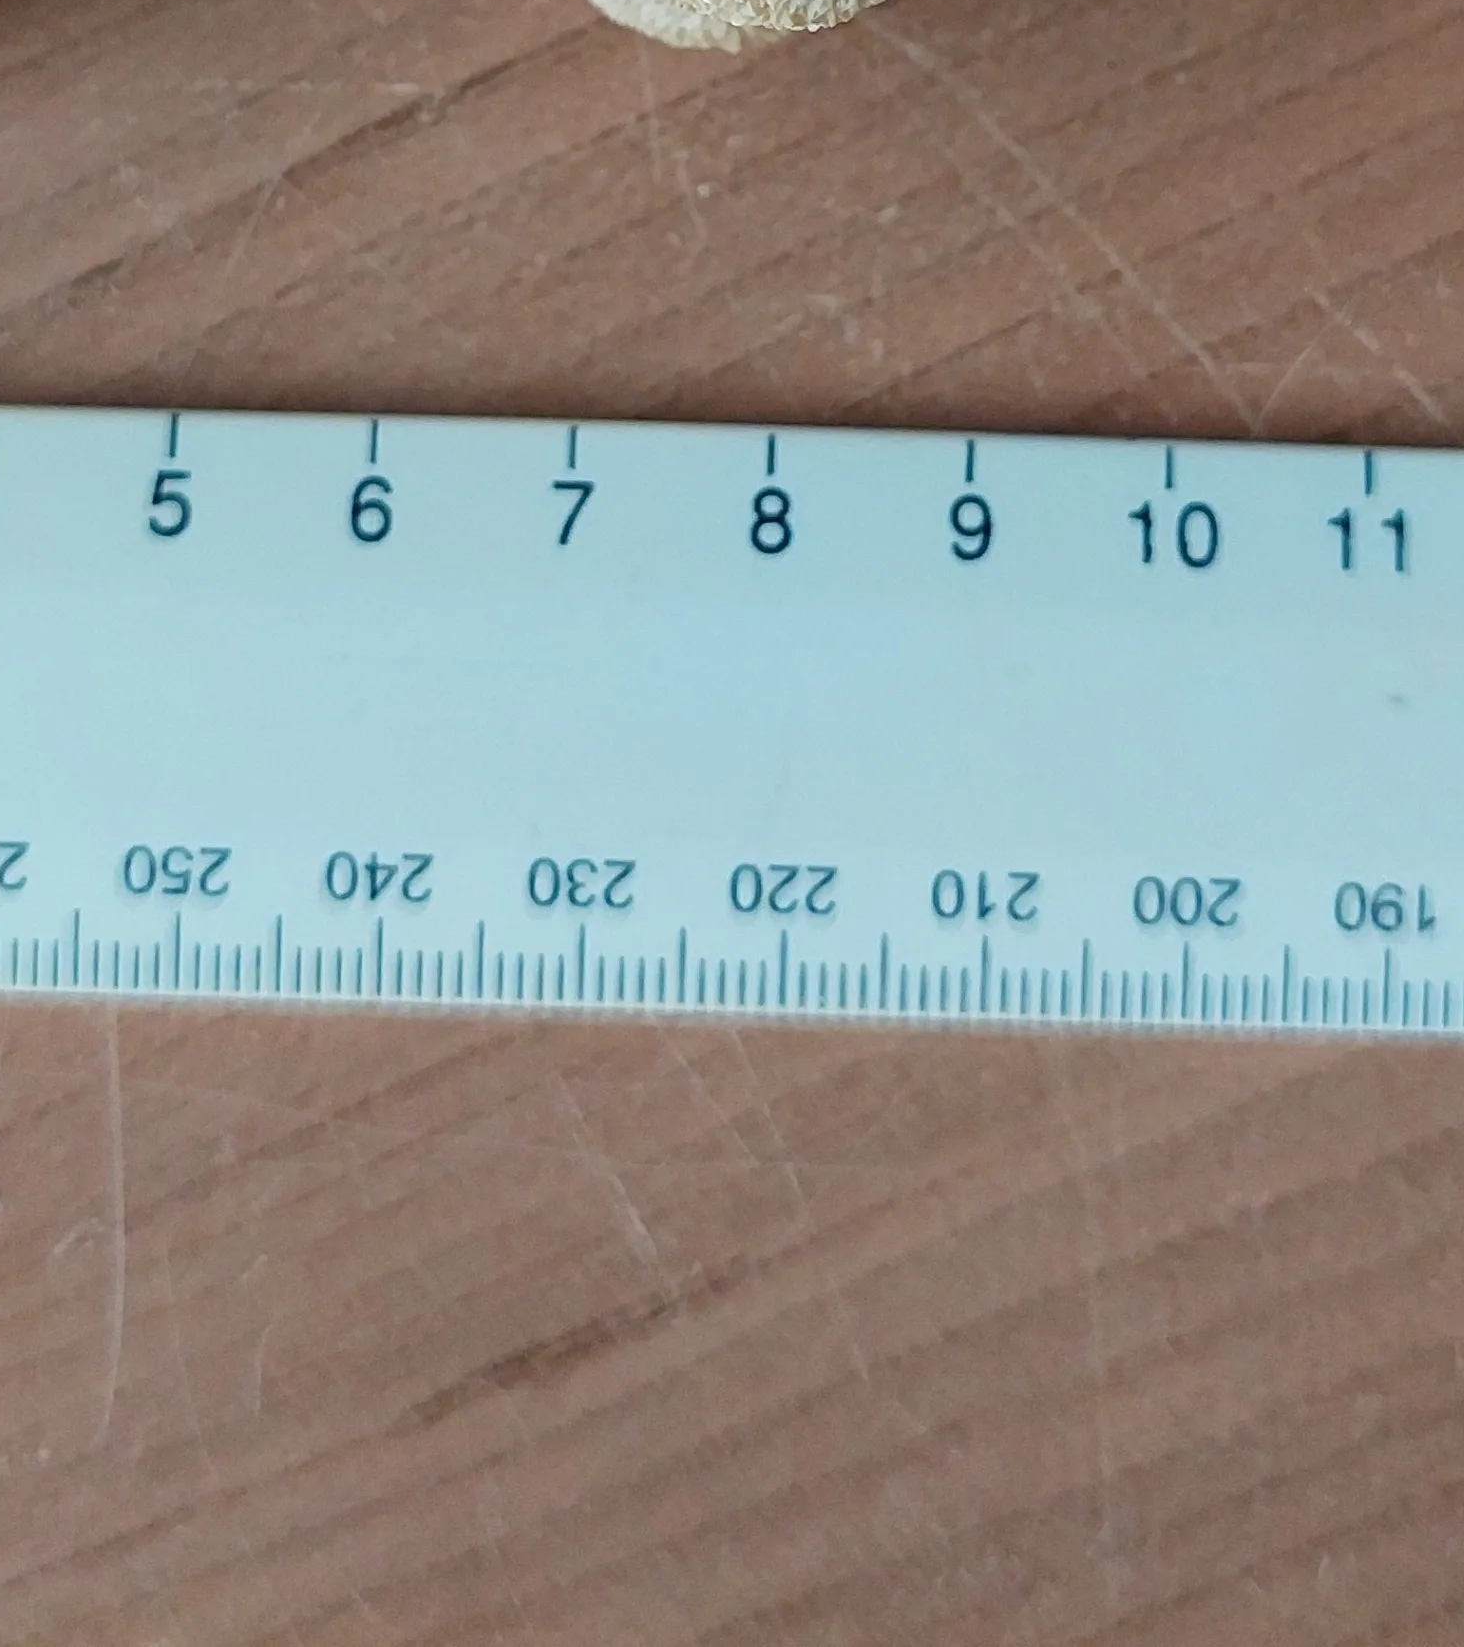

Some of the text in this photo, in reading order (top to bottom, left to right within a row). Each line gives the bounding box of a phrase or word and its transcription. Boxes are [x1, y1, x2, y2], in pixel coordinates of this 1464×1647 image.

[148, 470, 192, 538] 5
[348, 475, 393, 545] 6
[552, 480, 594, 545] 7
[749, 486, 794, 556] 8
[949, 493, 994, 562] 9
[1128, 501, 1220, 569] 10
[1328, 508, 1408, 572] 11
[123, 846, 231, 897] 250
[325, 852, 433, 903] 240
[528, 858, 636, 910] 230
[730, 864, 837, 915] 220
[932, 870, 1040, 922] 210
[1133, 877, 1240, 927] 200
[1335, 882, 1437, 933] 190
